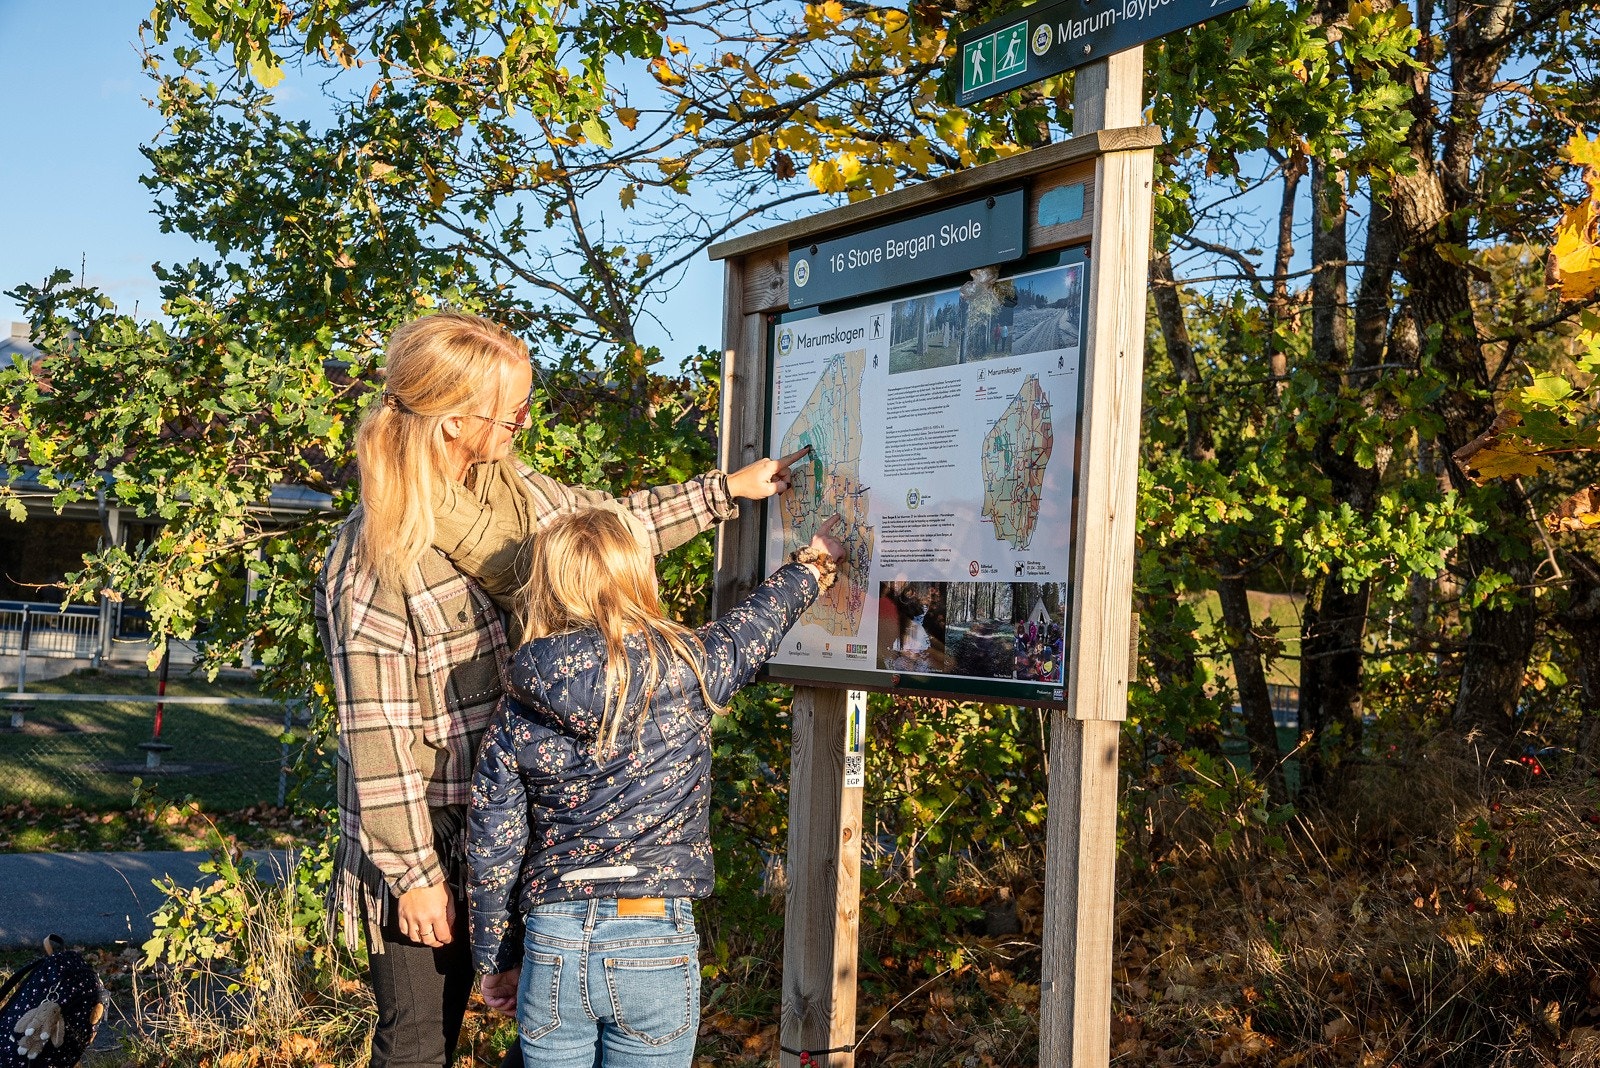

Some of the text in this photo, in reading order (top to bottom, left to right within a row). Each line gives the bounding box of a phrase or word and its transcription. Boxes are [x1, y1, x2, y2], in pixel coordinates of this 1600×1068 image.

[1058, 0, 1175, 44] Marum-løyp
[830, 219, 982, 274] 16 Store Bergan Skole
[797, 327, 864, 350] Marumskogen
[987, 366, 1022, 377] Marumskogen
[850, 692, 861, 701] 44
[846, 778, 860, 786] EGP
